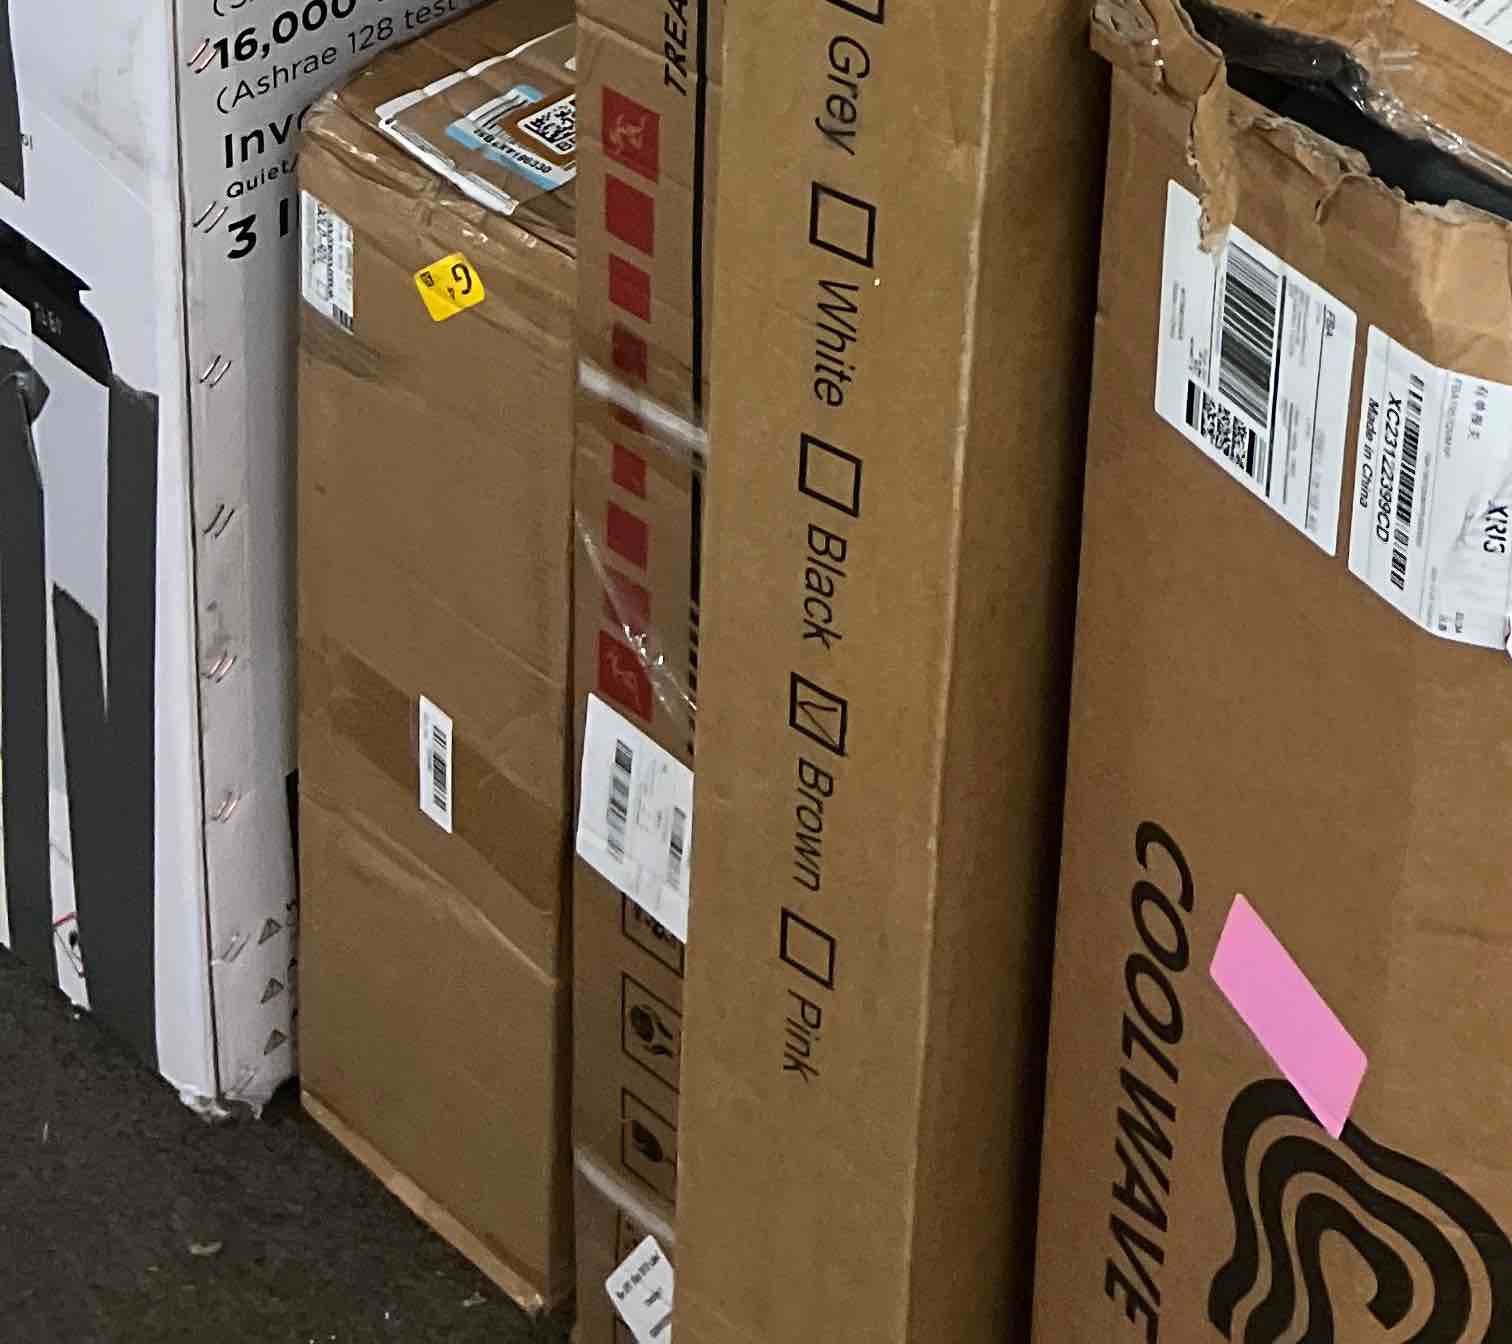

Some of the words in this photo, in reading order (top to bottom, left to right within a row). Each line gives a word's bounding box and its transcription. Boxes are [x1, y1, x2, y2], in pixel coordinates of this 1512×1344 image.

[216, 44, 338, 115] (Ashrae
[347, 15, 395, 55] 128
[814, 35, 871, 157] Grey
[226, 213, 258, 260] 3
[814, 280, 860, 409] White
[1365, 397, 1380, 442] Made
[1359, 464, 1375, 509] China
[802, 522, 847, 652] Black
[792, 755, 835, 895] Brown
[782, 987, 823, 1084] Pink
[1104, 820, 1195, 1344] COOLWAVE
